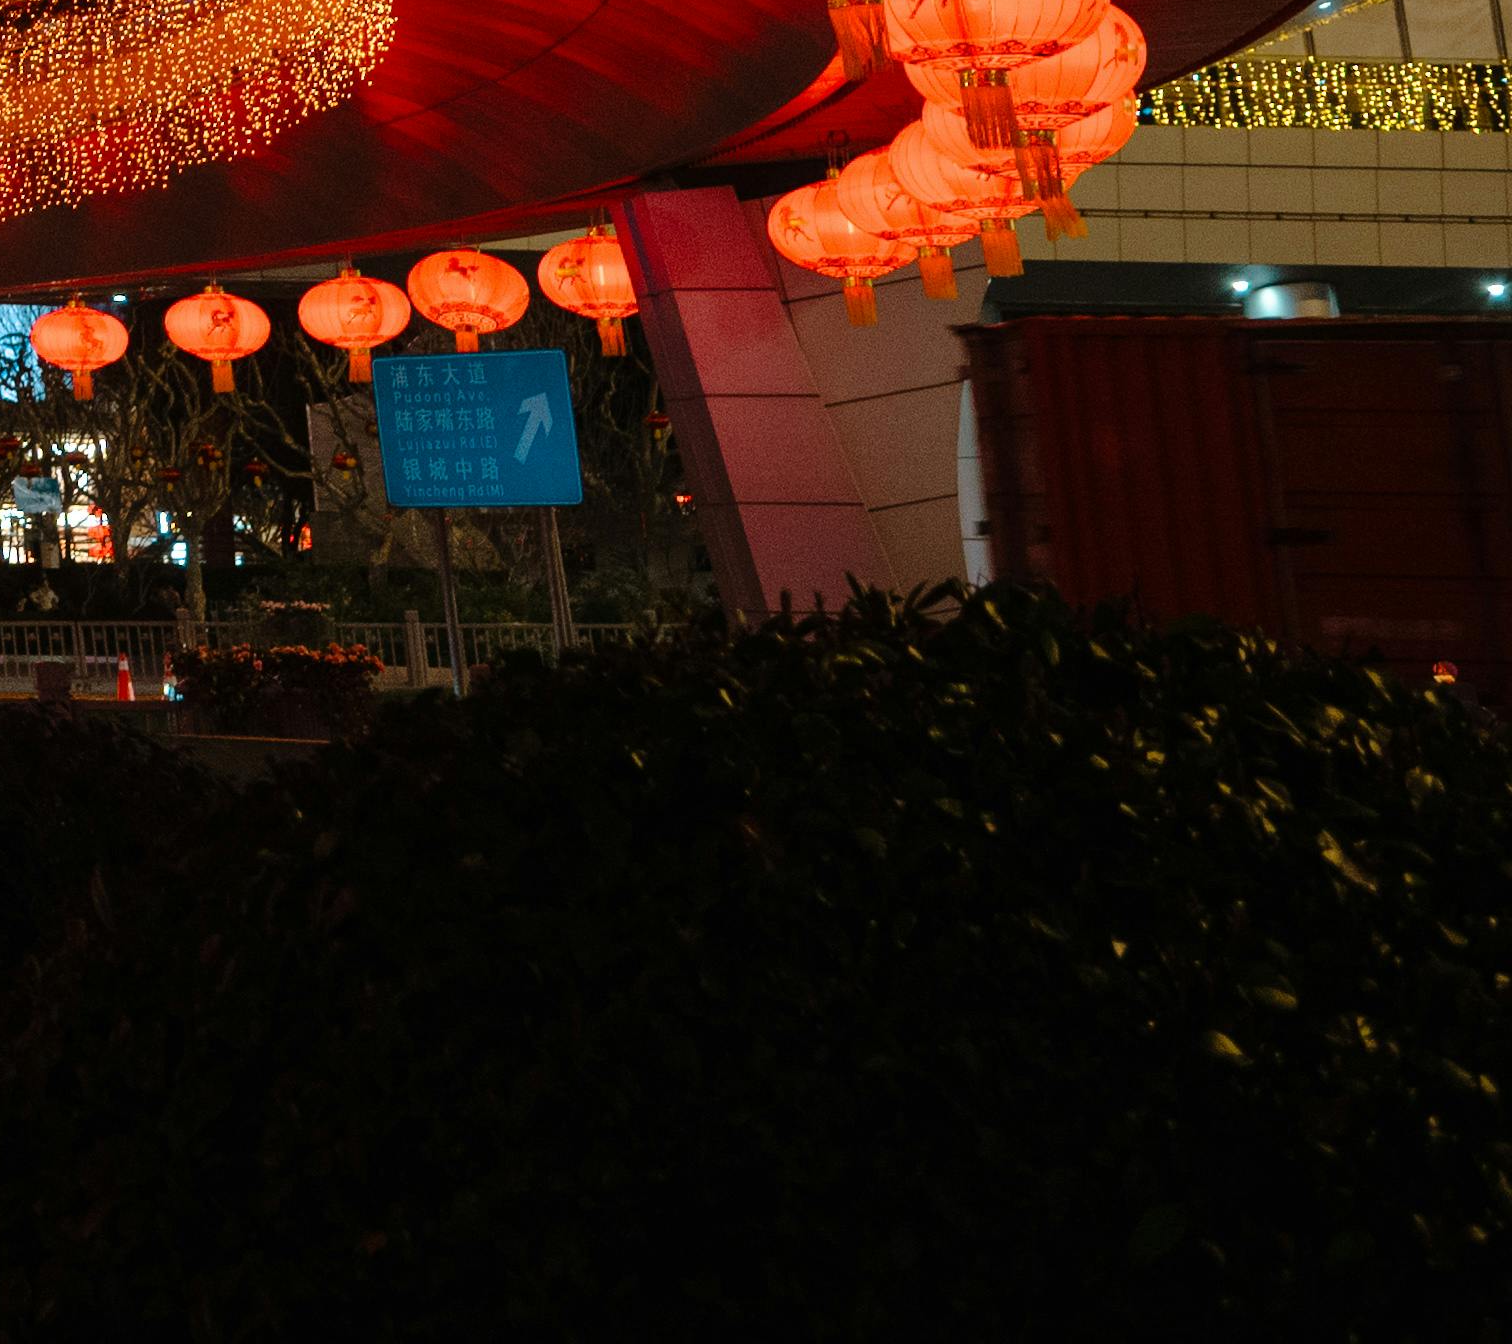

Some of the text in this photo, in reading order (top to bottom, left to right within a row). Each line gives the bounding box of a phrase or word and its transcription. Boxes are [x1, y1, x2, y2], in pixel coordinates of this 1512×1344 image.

[390, 362, 488, 389] 浦东大道
[394, 391, 452, 407] Pudong
[395, 407, 495, 433] 陆家嘴东路
[402, 457, 499, 481] 银城中路
[403, 485, 464, 502] Yincheng
